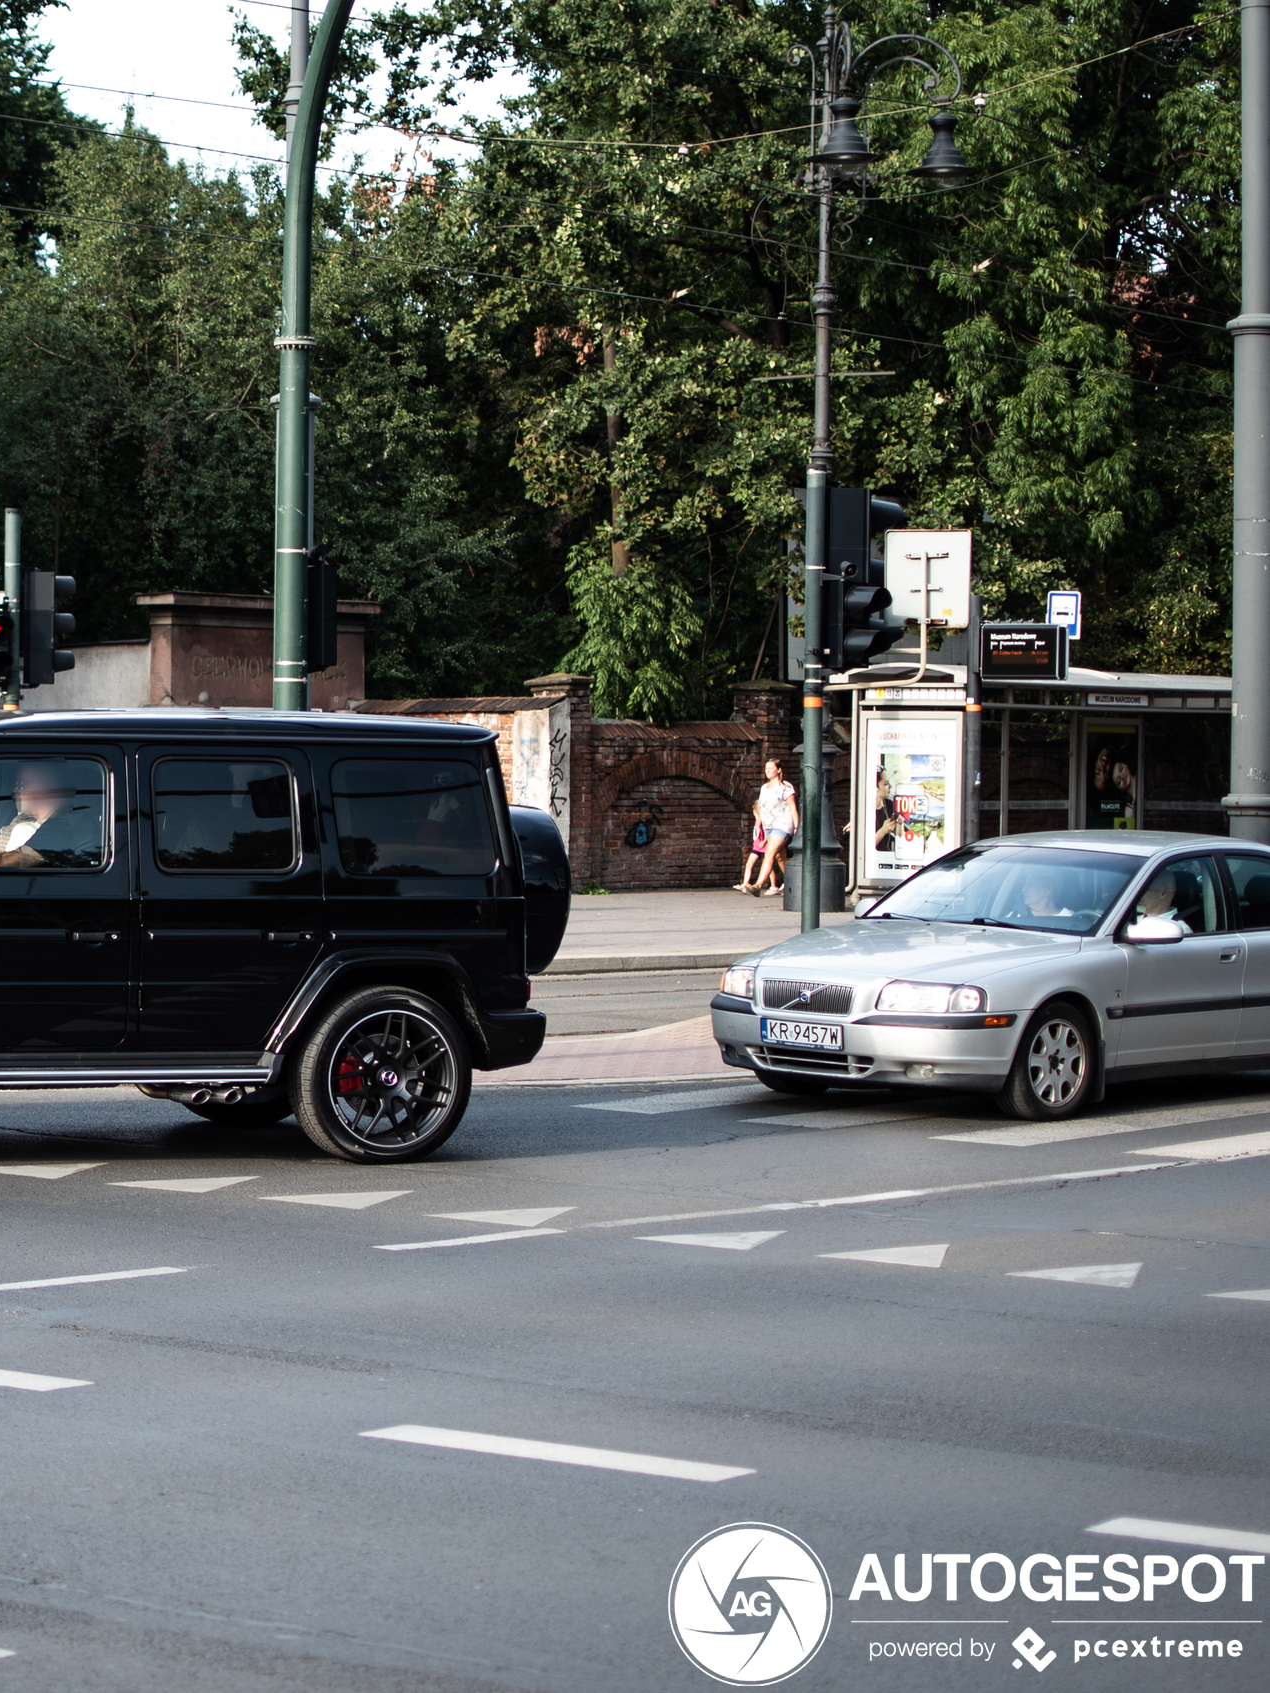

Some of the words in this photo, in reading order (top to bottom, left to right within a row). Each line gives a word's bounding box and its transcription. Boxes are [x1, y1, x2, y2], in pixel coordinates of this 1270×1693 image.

[1095, 694, 1114, 703] MUZEUM
[1115, 695, 1141, 704] NARODOWE
[895, 796, 917, 813] TOK
[917, 797, 927, 812] FM
[770, 1021, 789, 1040] KR
[793, 1024, 838, 1045] 9457W
